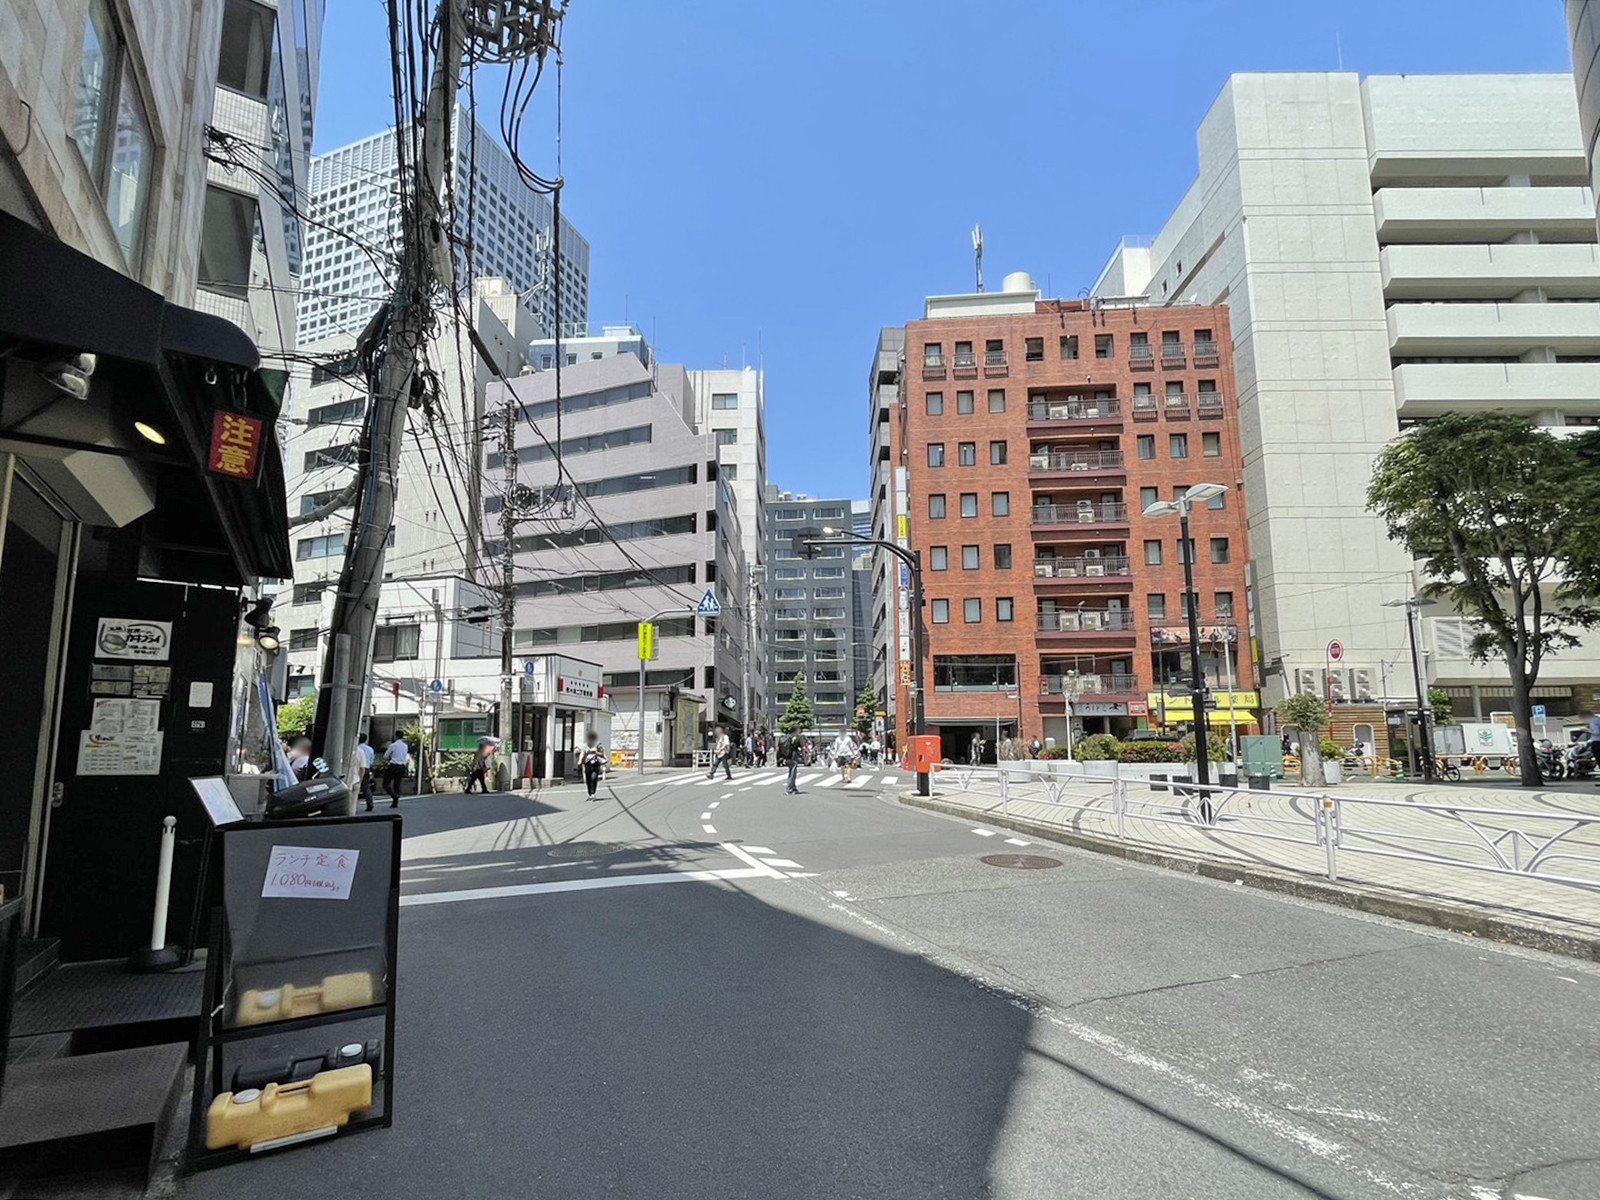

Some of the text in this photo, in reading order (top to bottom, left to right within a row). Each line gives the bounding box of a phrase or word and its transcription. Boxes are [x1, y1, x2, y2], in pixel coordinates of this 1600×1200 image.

[216, 414, 254, 474] 注意
[125, 633, 162, 644] カキフライ
[1155, 694, 1254, 704] セントル薬局
[276, 852, 349, 869] ランチ定食
